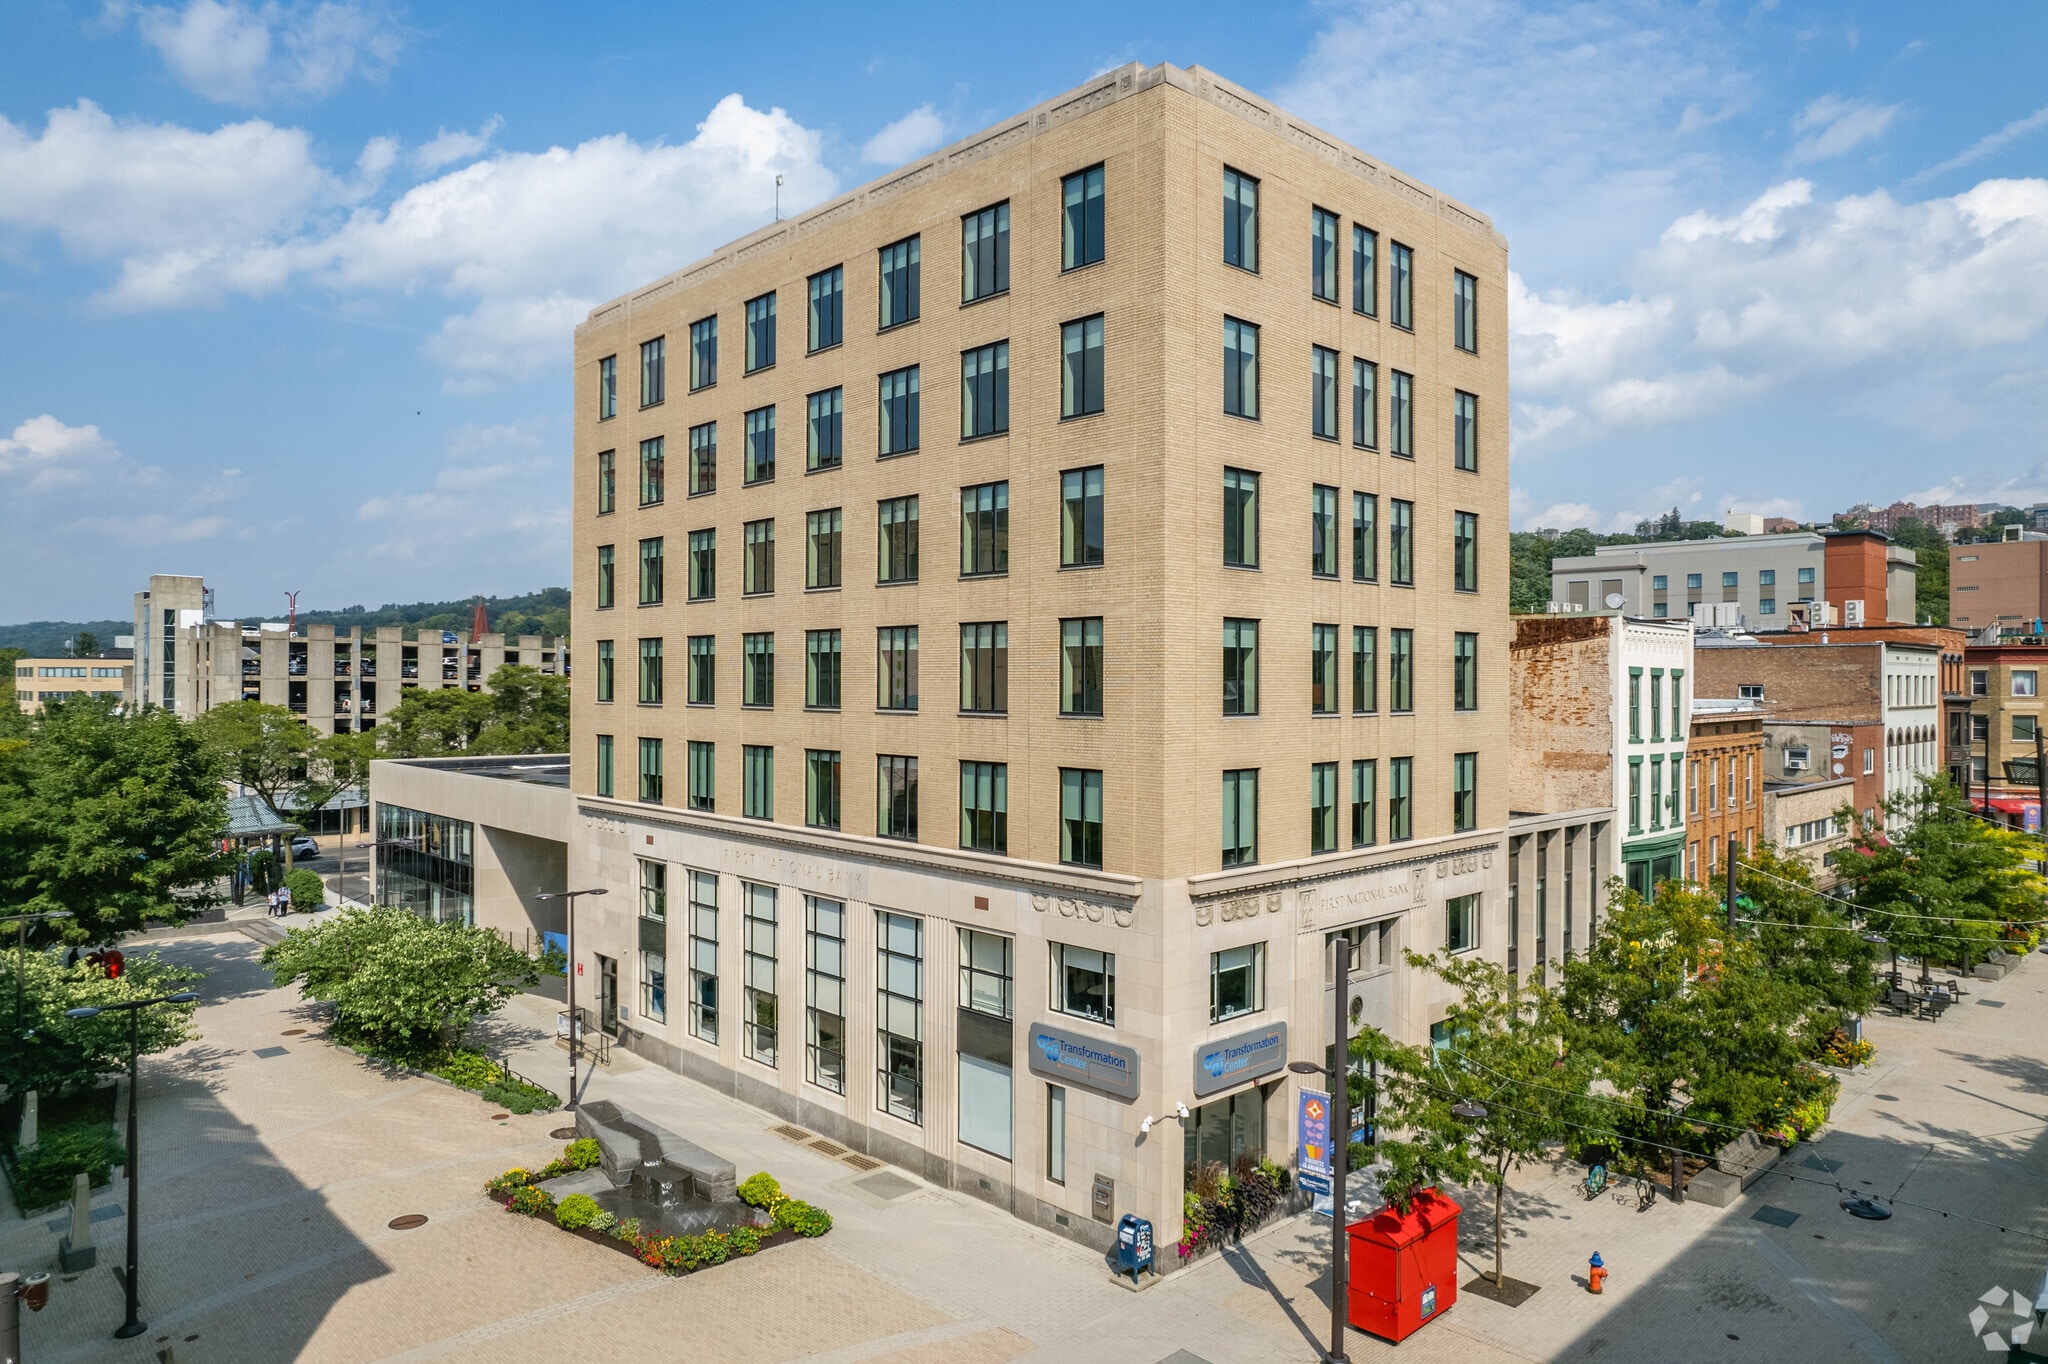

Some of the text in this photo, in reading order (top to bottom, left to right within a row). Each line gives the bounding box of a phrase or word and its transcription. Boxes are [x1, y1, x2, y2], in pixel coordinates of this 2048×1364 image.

[724, 849, 862, 886] FIRST NATIONAL BANK
[1321, 883, 1409, 911] FIRST NATIONAL BANK
[1059, 1040, 1126, 1068] Transformation
[1224, 1035, 1279, 1060] Transformation
[1059, 1052, 1087, 1070] Center
[1224, 1057, 1249, 1073] Center
